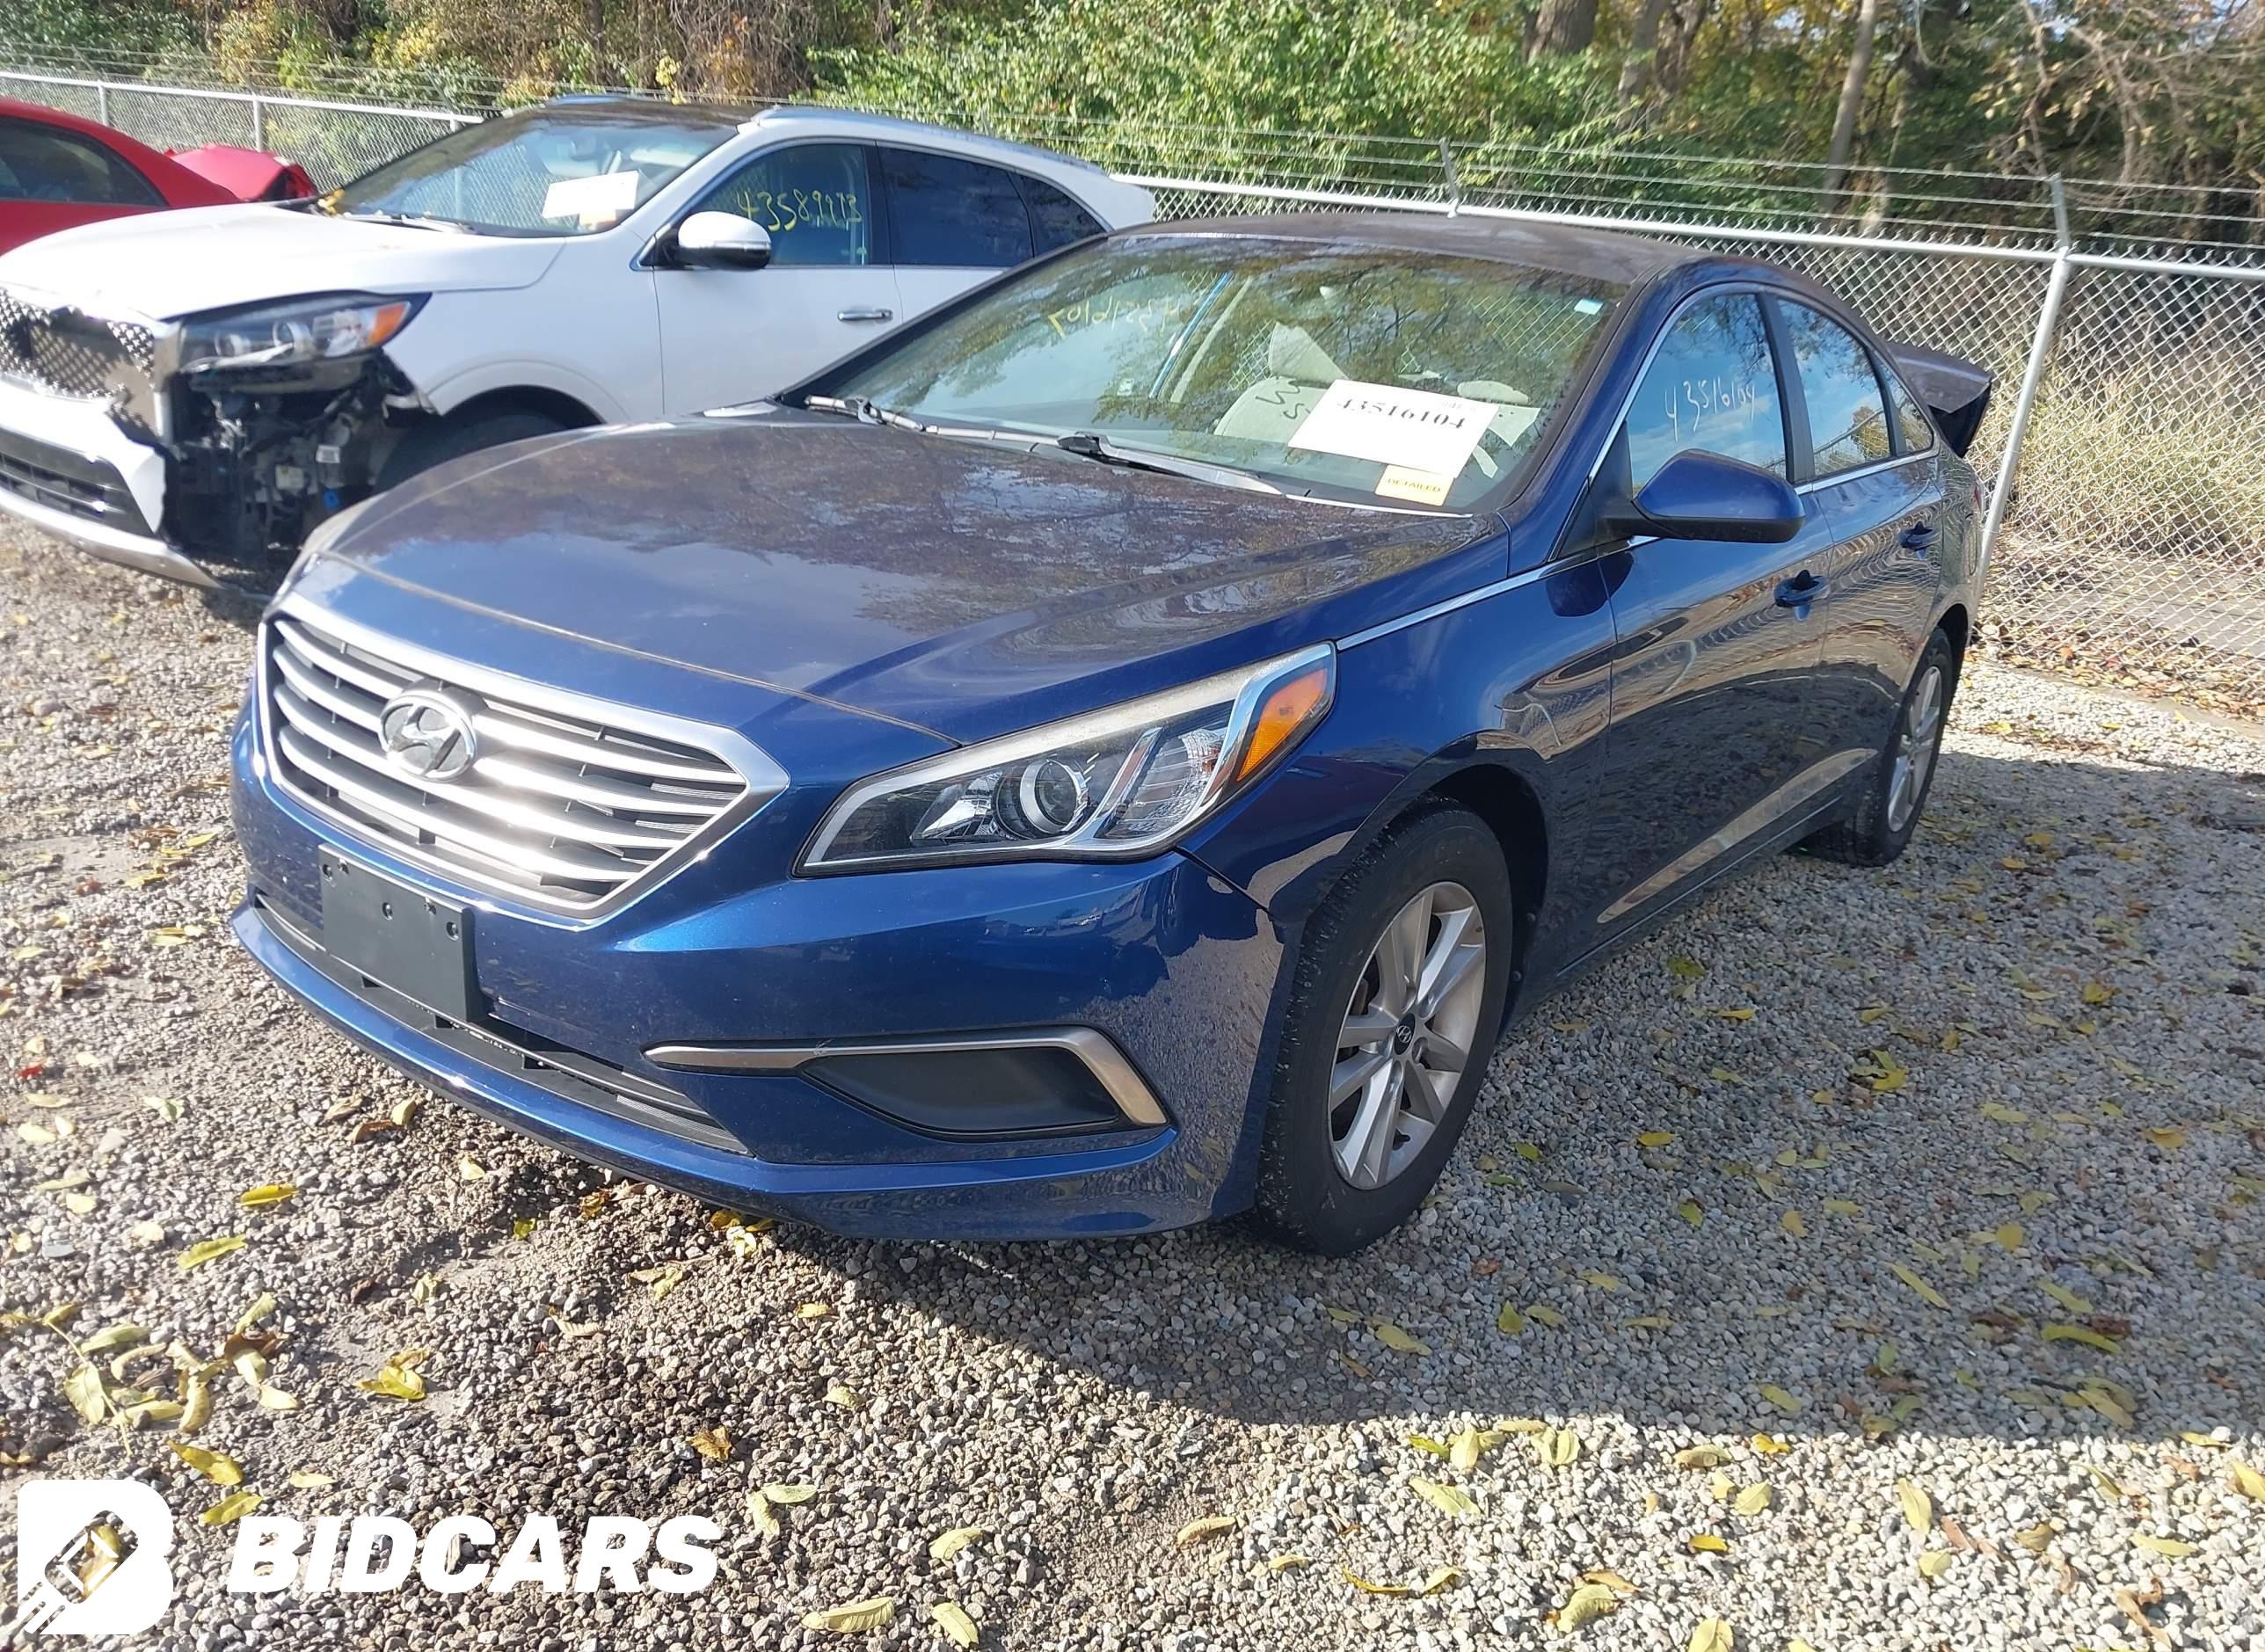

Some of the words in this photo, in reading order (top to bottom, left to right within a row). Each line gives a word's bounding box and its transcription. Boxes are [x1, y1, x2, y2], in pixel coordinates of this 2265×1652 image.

[1337, 398, 1466, 429] 43516104
[1664, 375, 1755, 443] 43516104
[1387, 477, 1441, 493] DETAILED
